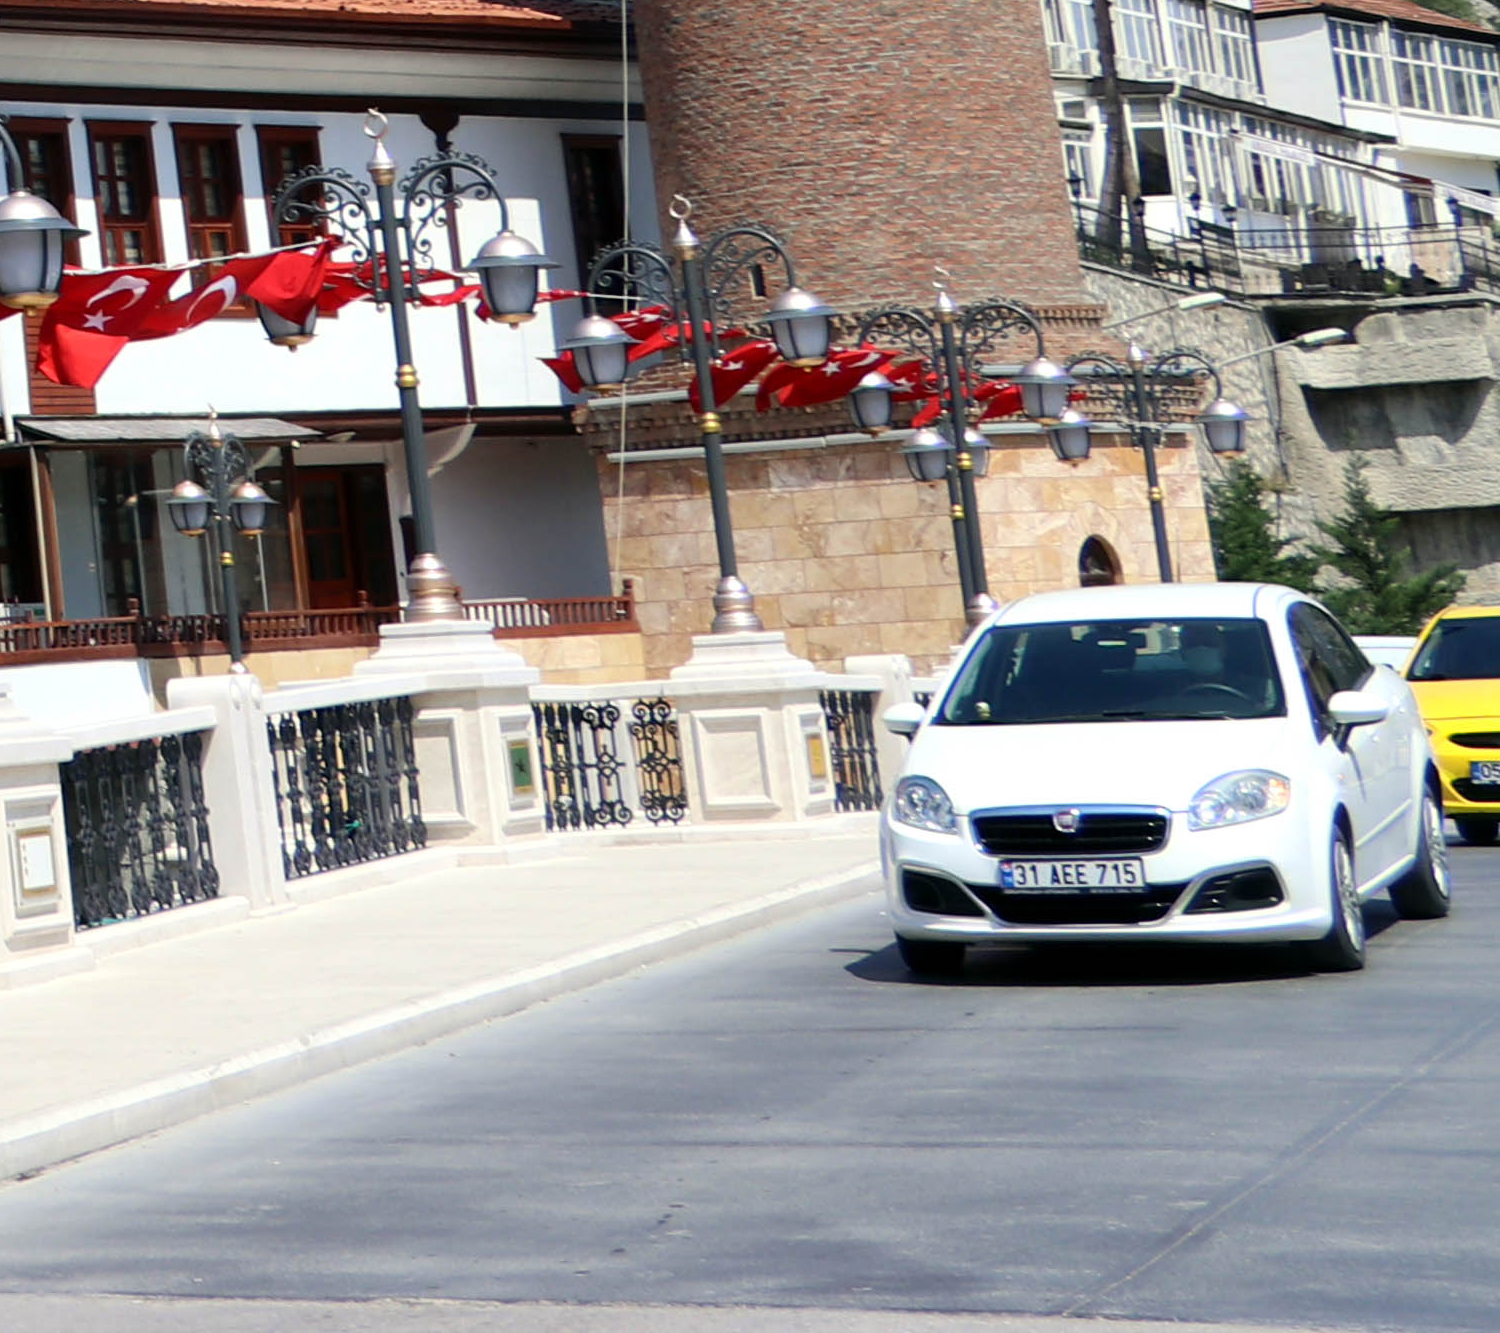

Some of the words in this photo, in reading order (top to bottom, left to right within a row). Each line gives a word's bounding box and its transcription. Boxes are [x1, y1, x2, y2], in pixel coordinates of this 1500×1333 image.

[1015, 864, 1038, 885] 31
[1051, 864, 1088, 885] AEE
[1095, 863, 1137, 885] 715
